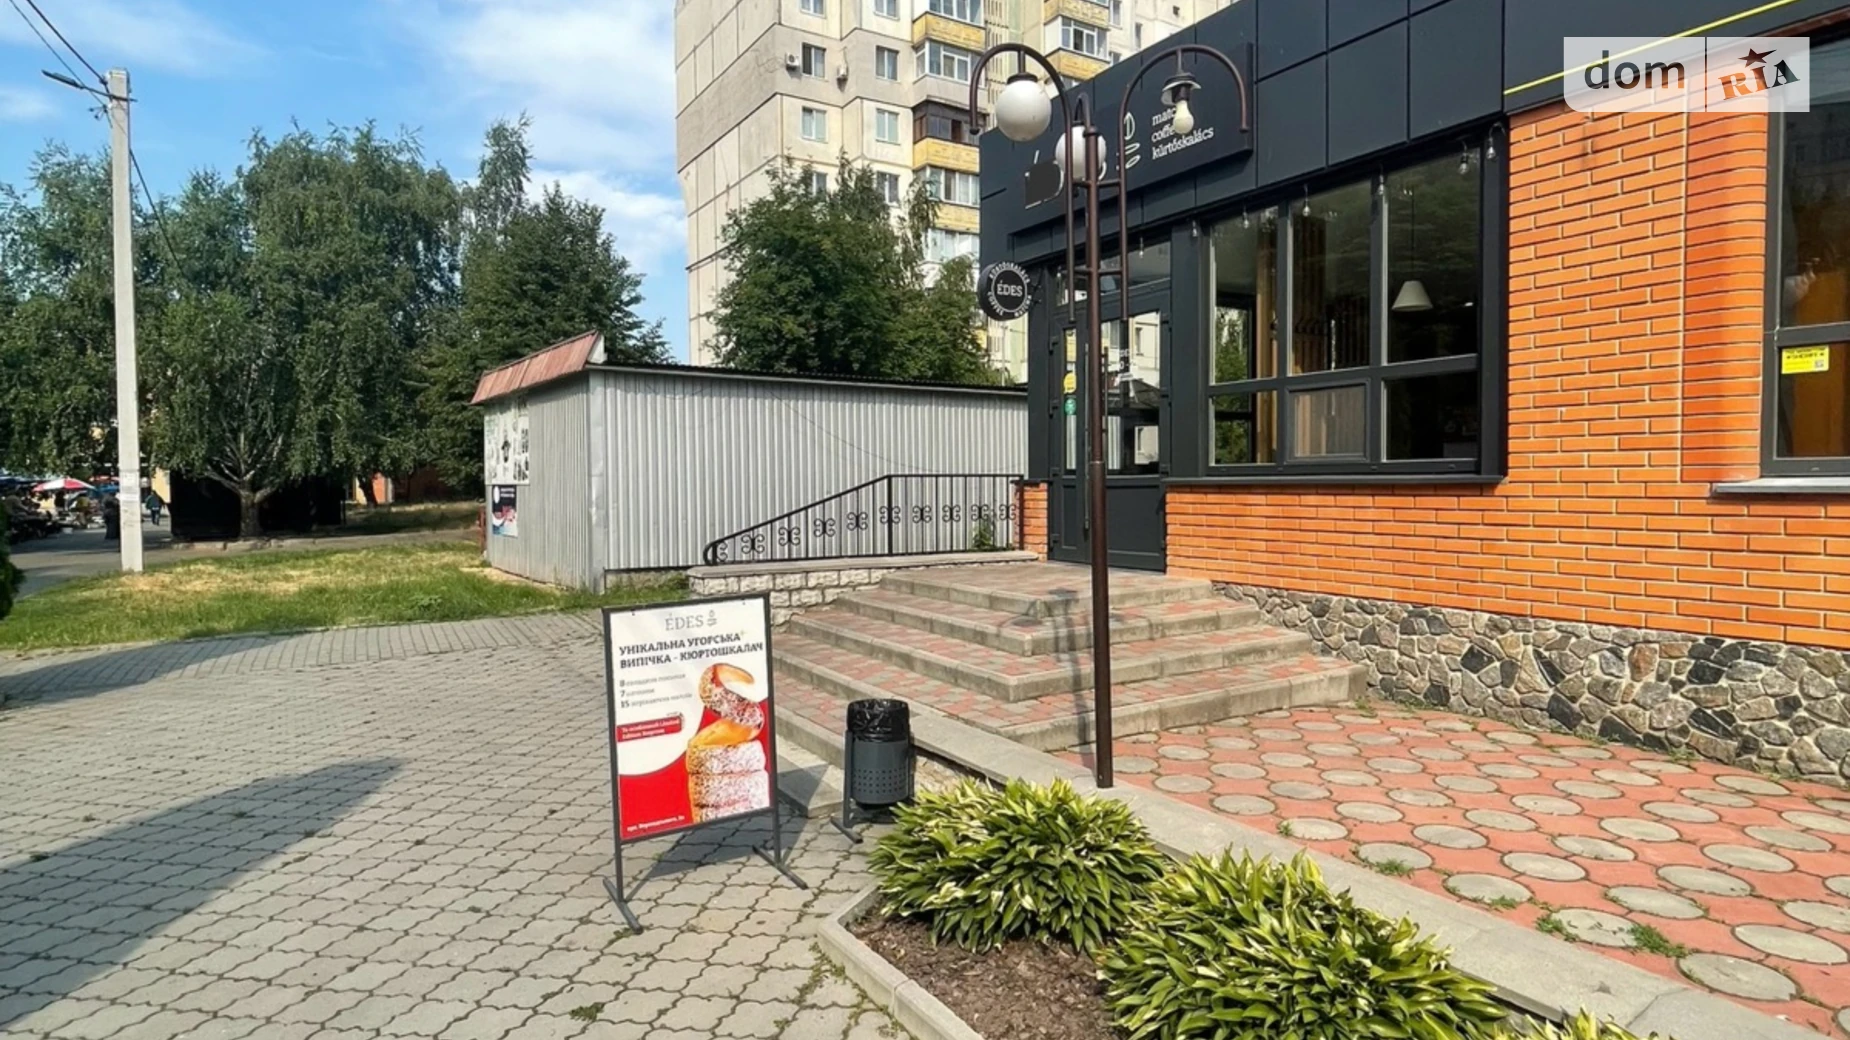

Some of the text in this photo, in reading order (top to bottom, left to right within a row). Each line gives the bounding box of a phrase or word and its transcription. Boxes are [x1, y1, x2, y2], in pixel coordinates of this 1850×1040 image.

[1151, 123, 1176, 143] coffe
[997, 279, 1023, 297] ÉDES
[664, 612, 704, 631] ÉDES
[619, 632, 741, 656] УНІКАЛЬНА УГОРСЬКА
[620, 654, 672, 669] ВИПІЧКА
[680, 642, 764, 662] КЮРТОШКАЛАЧ
